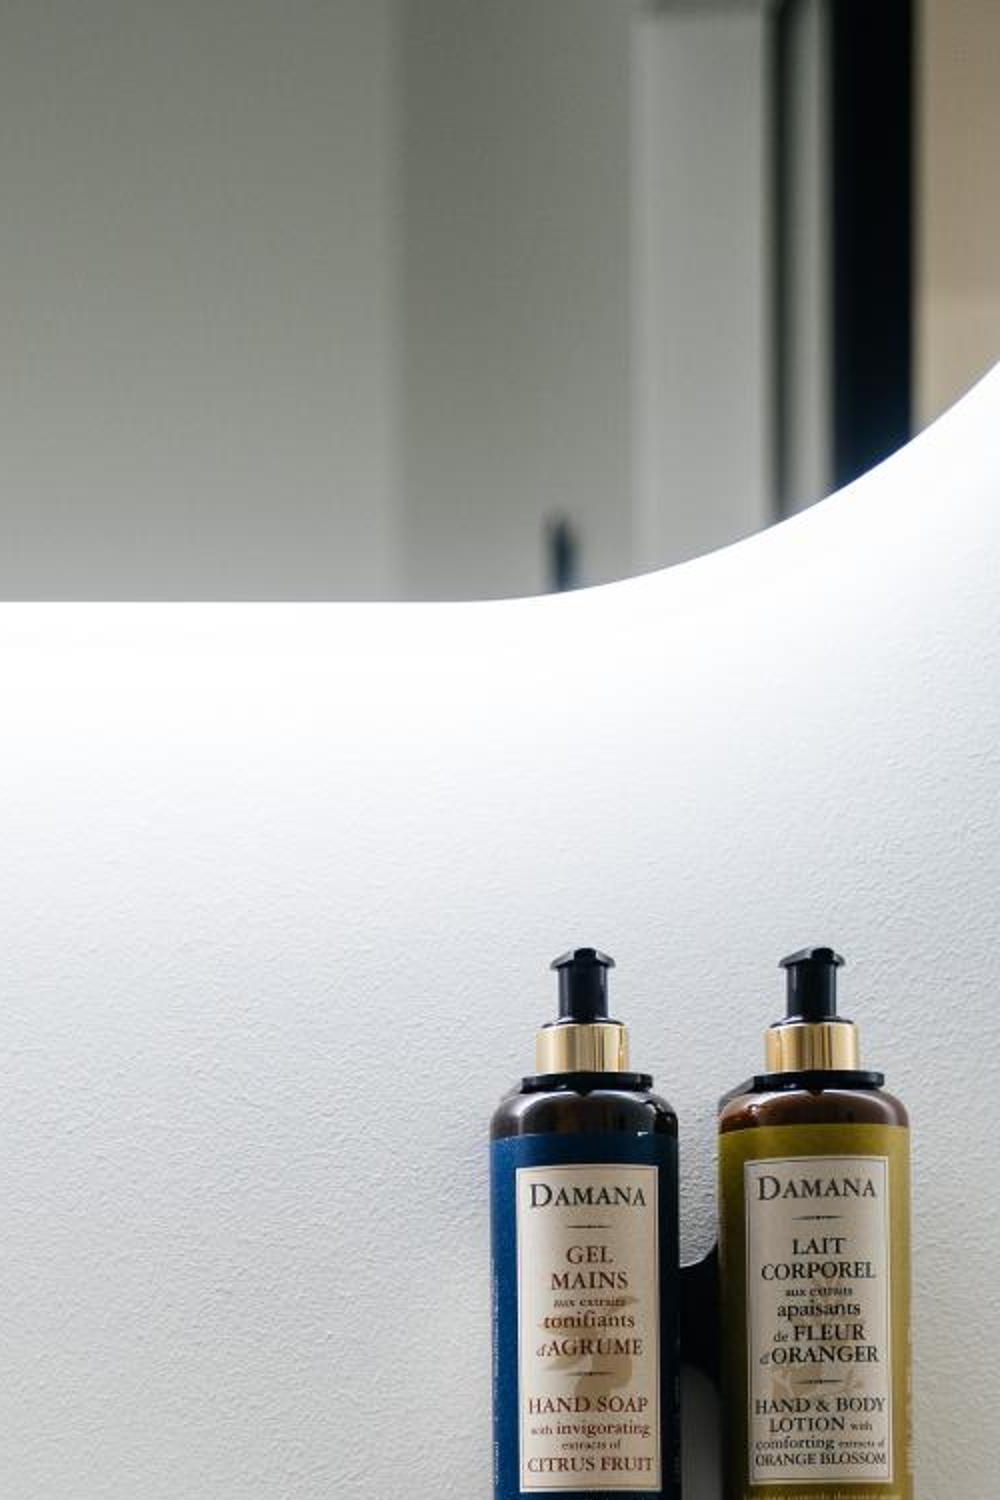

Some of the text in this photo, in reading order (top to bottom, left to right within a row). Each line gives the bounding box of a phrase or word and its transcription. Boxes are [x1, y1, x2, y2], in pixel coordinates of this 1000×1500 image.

[565, 1245, 614, 1265] GEL
[792, 1237, 848, 1255] LAIT
[551, 1271, 629, 1290] MAINS
[761, 1261, 878, 1281] CORPOREL
[543, 1310, 636, 1329] tonifiants
[777, 1299, 861, 1321] apaisants
[773, 1323, 867, 1343] de FLEUR
[529, 1396, 649, 1415] HAND SOAP
[755, 1397, 887, 1415] HAND & BODY
[556, 1420, 652, 1439] invigorating
[769, 1416, 846, 1433] LOTION
[755, 1435, 836, 1452] comforting
[527, 1455, 655, 1473] CITRUS FRUIT
[755, 1451, 887, 1467] ORANGE BLOSSOM
